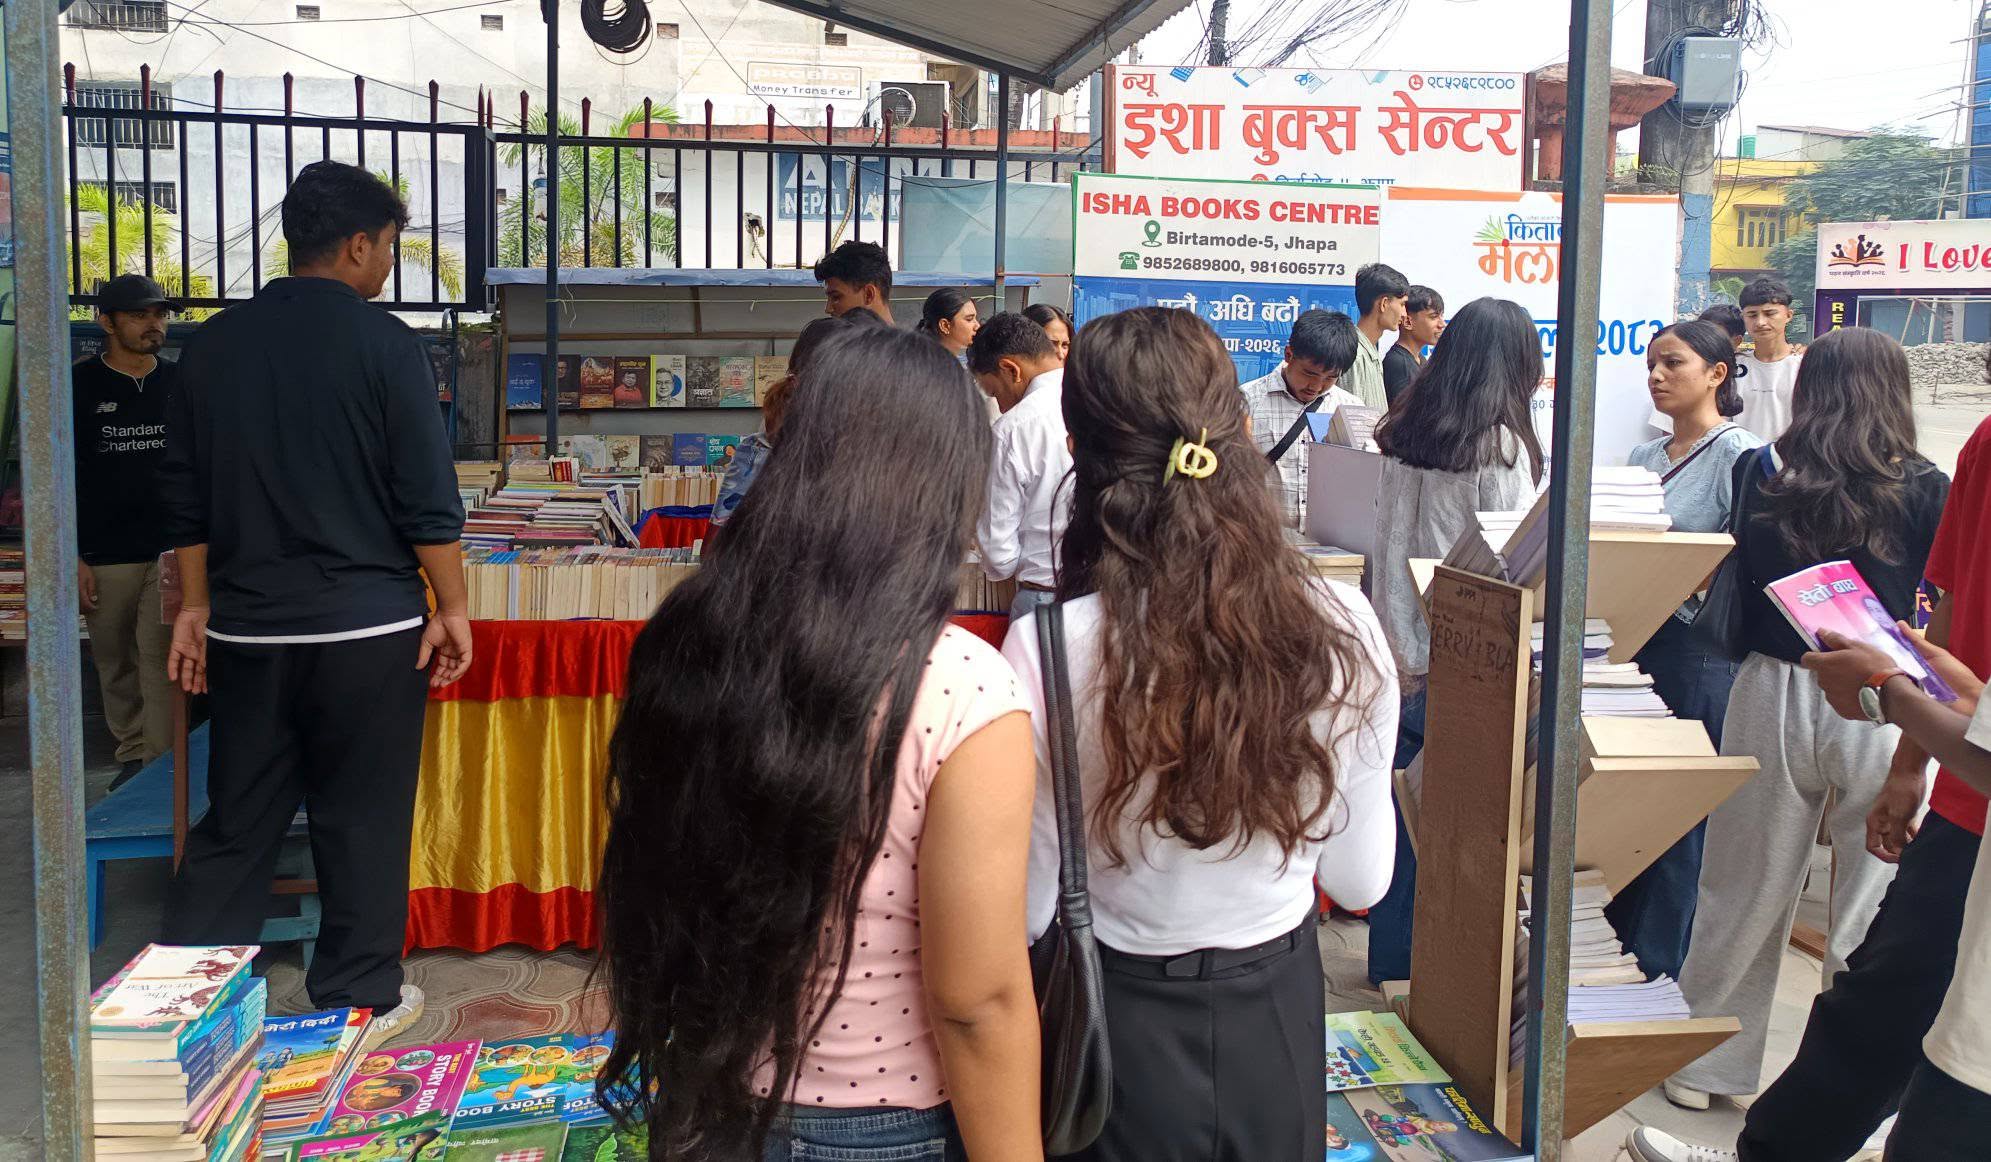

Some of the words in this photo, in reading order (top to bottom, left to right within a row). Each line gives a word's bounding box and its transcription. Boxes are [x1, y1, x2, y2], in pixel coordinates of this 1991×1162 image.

[753, 85, 788, 95] Money
[793, 86, 853, 96] Transfer
[1123, 104, 1225, 159] इशा
[1242, 104, 1361, 165] बुक्स
[1378, 91, 1522, 156] सेन्टर
[784, 192, 845, 215] NEPAL
[1082, 192, 1152, 216] ISHA
[1161, 196, 1260, 221] BOOKS
[1269, 201, 1380, 226] CENTRE
[1166, 231, 1279, 251] Birtamode-5,
[1284, 235, 1338, 253] Jhapa
[1143, 257, 1245, 274] 9852689800,
[1250, 261, 1346, 276] 9816065773
[1899, 243, 1909, 269] I
[426, 1054, 452, 1086] STORY
[456, 1107, 493, 1118] BOO
[498, 1096, 556, 1112] STORY
